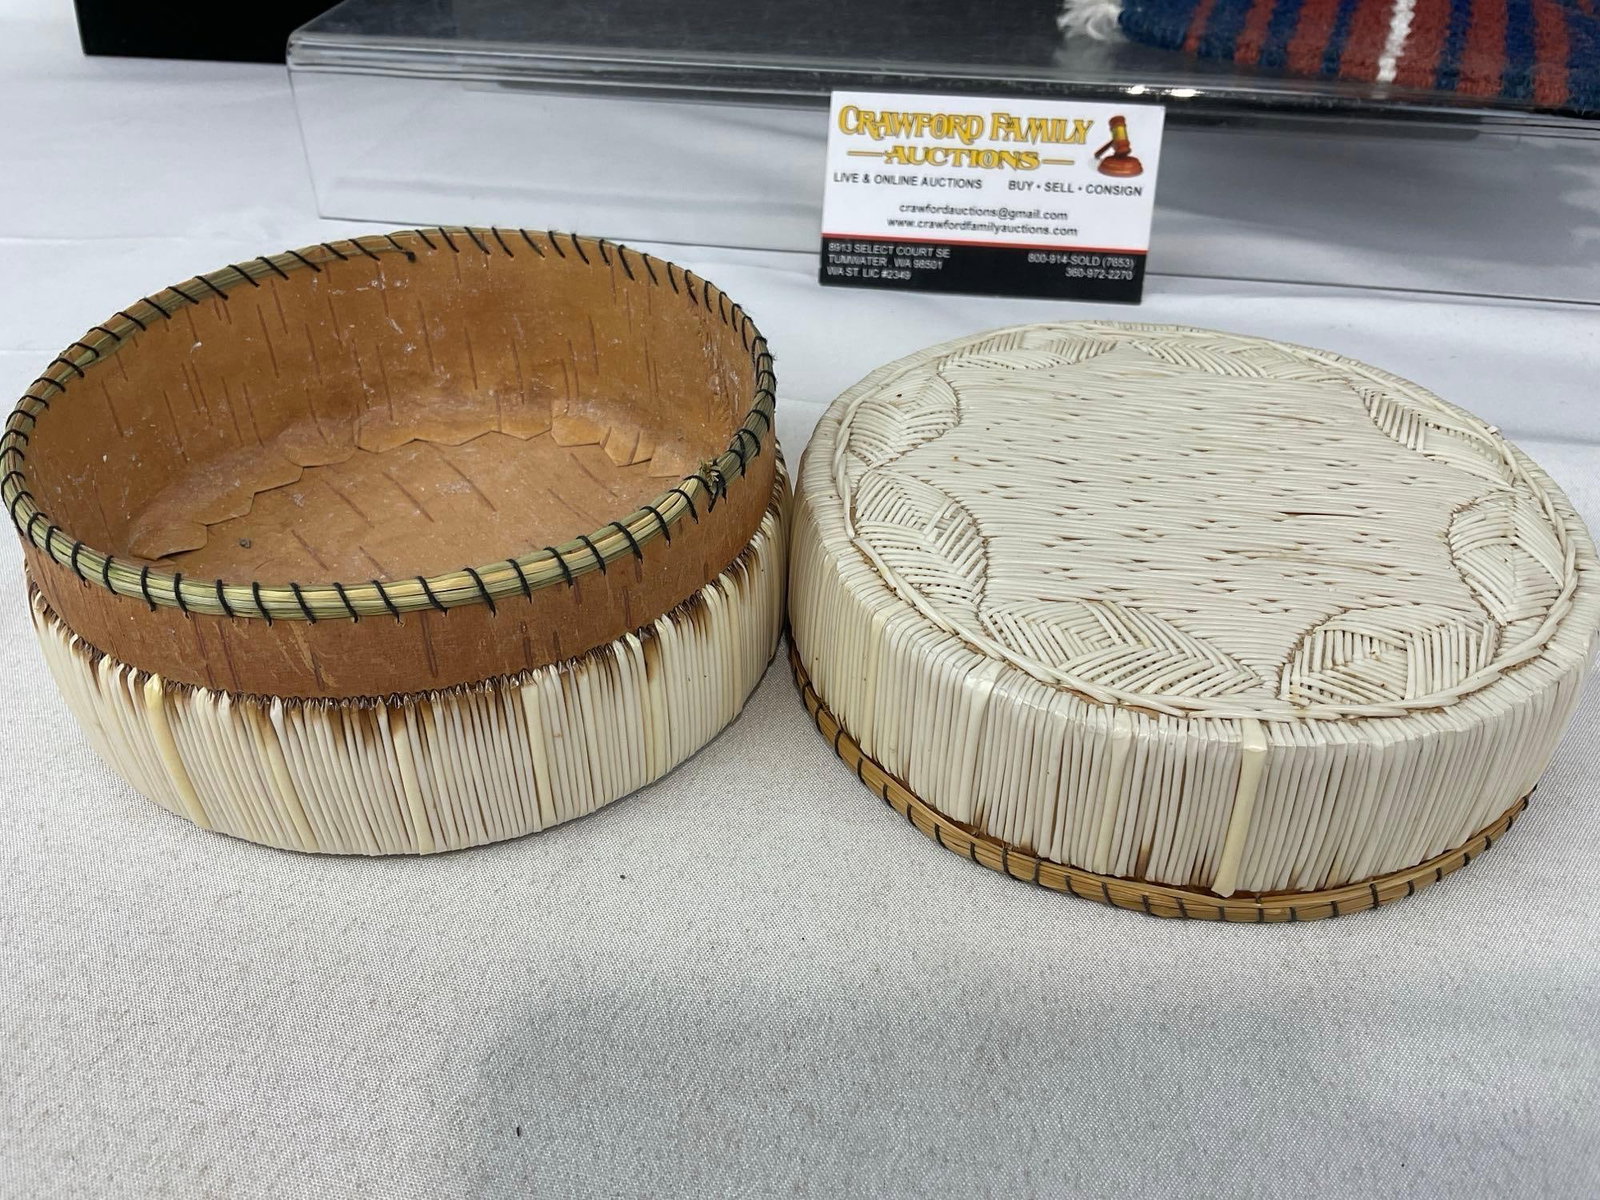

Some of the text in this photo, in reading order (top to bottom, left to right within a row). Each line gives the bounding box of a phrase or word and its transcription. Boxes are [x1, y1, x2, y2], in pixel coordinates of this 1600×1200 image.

[838, 105, 1094, 145] CRAWFORD FAMILY
[884, 145, 1041, 171] AUCTIONS
[833, 172, 983, 190] LIVE & ONLINE AUCTIONS
[1008, 180, 1143, 197] BUY SELL CONSIGN
[899, 203, 1068, 221] crawfordauctions@gmail.com
[887, 218, 1079, 237] www.crawfordfamilyauctions.com
[853, 244, 894, 256] SELECT
[895, 246, 934, 257] COURT
[935, 248, 951, 259] SE
[1027, 252, 1100, 266] 800-914-SOLD
[893, 258, 912, 268] WA
[827, 266, 843, 276] WA
[862, 269, 880, 278] LIC
[1065, 267, 1134, 281] 360-972-2270
